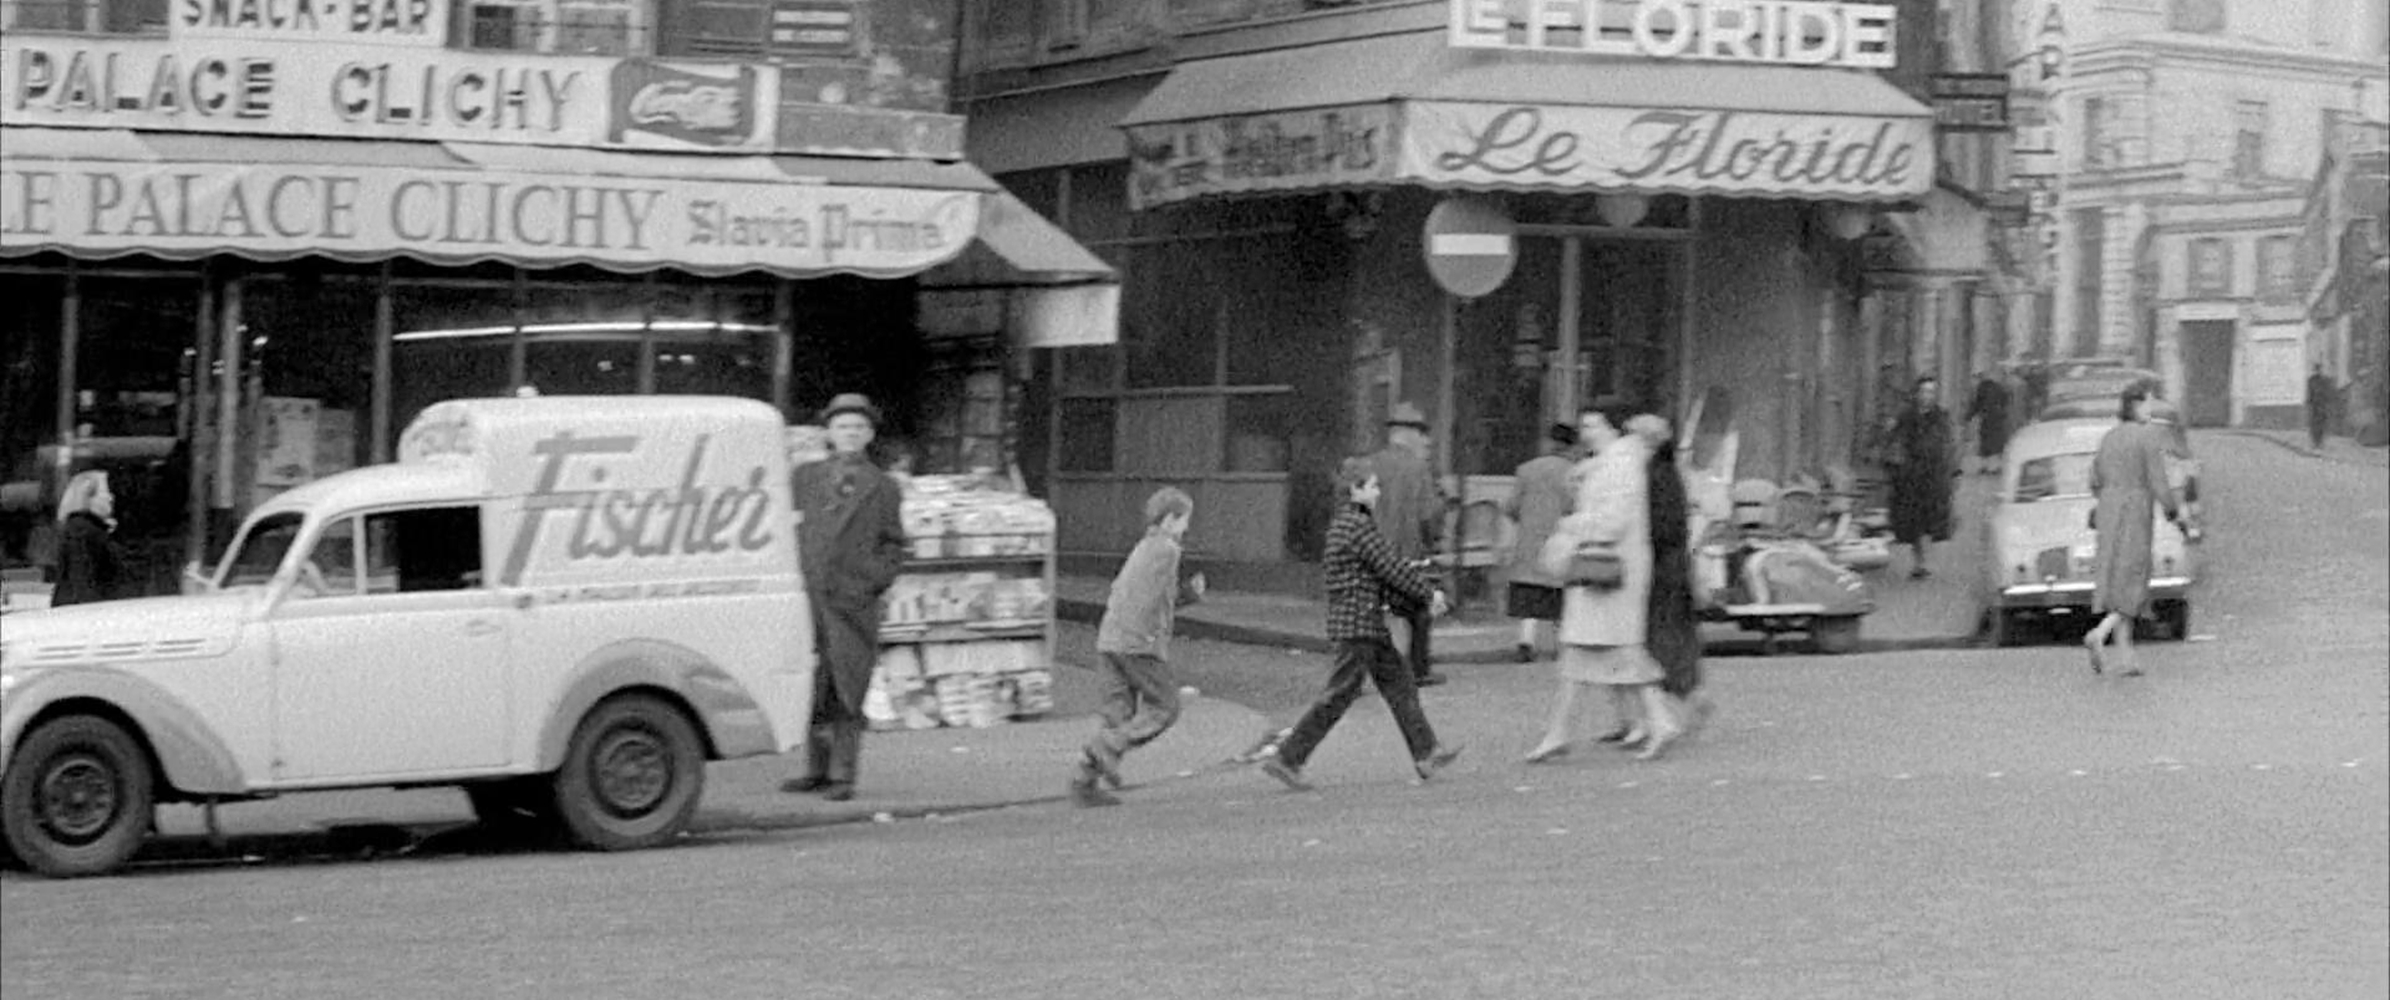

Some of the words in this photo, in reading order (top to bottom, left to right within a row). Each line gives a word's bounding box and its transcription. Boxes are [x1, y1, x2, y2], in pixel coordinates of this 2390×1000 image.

[183, 0, 430, 35] SNACK-BAR
[1527, 0, 1897, 67] FLORIDE
[15, 48, 275, 119] PALACE
[330, 62, 583, 131] CLICHY
[1439, 107, 1581, 177] Le
[1611, 109, 1913, 186] Floride
[0, 171, 58, 235] E
[82, 172, 361, 239] PALACE
[389, 178, 665, 251] CLICHY
[686, 200, 810, 248] Slavia
[500, 430, 772, 588] Fischer
